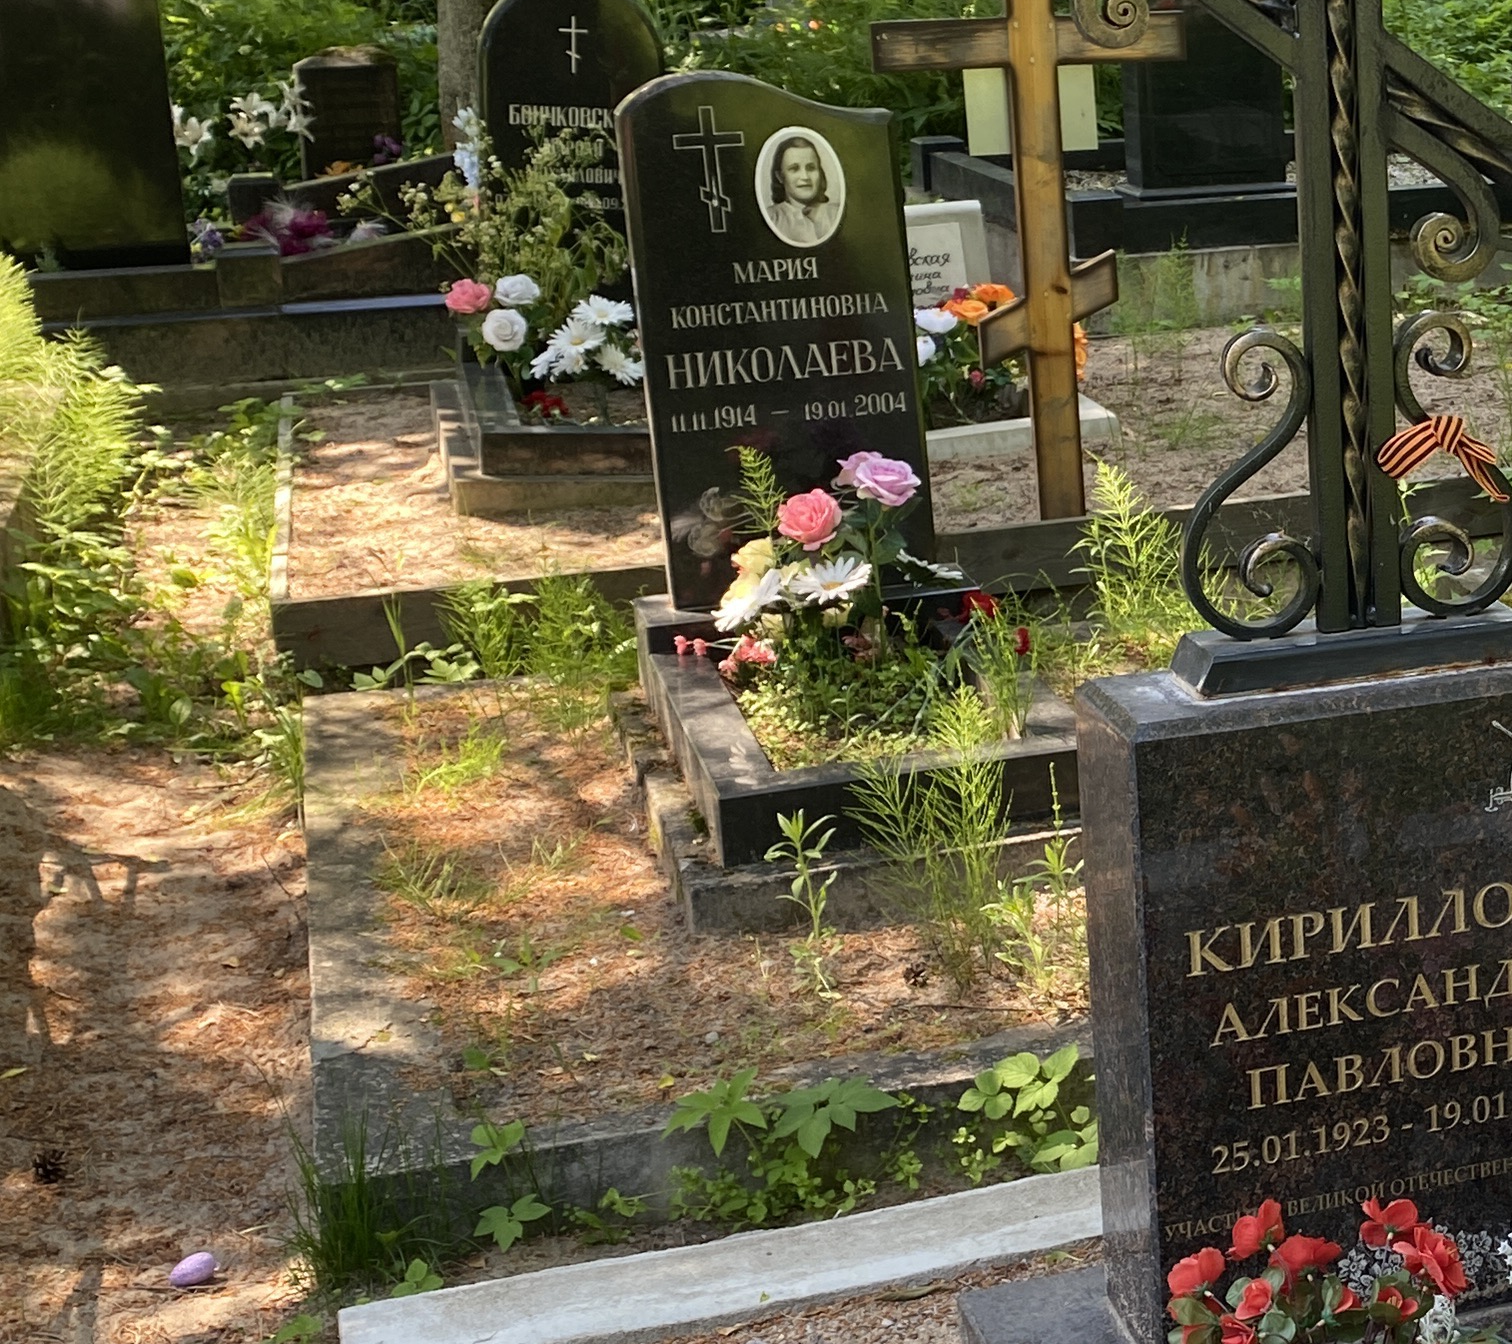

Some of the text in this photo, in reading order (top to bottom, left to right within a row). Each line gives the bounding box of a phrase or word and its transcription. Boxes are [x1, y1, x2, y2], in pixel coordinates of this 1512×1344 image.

[732, 256, 819, 284] МАРИЯ
[908, 247, 951, 267] вская
[669, 292, 889, 330] КОНСТАНТИНОВНА
[664, 337, 905, 390] НИКОЛАЕВА
[1211, 1120, 1391, 1175] 25.01.1923
[1286, 1179, 1385, 1218] ВЕЛИКОЙ
